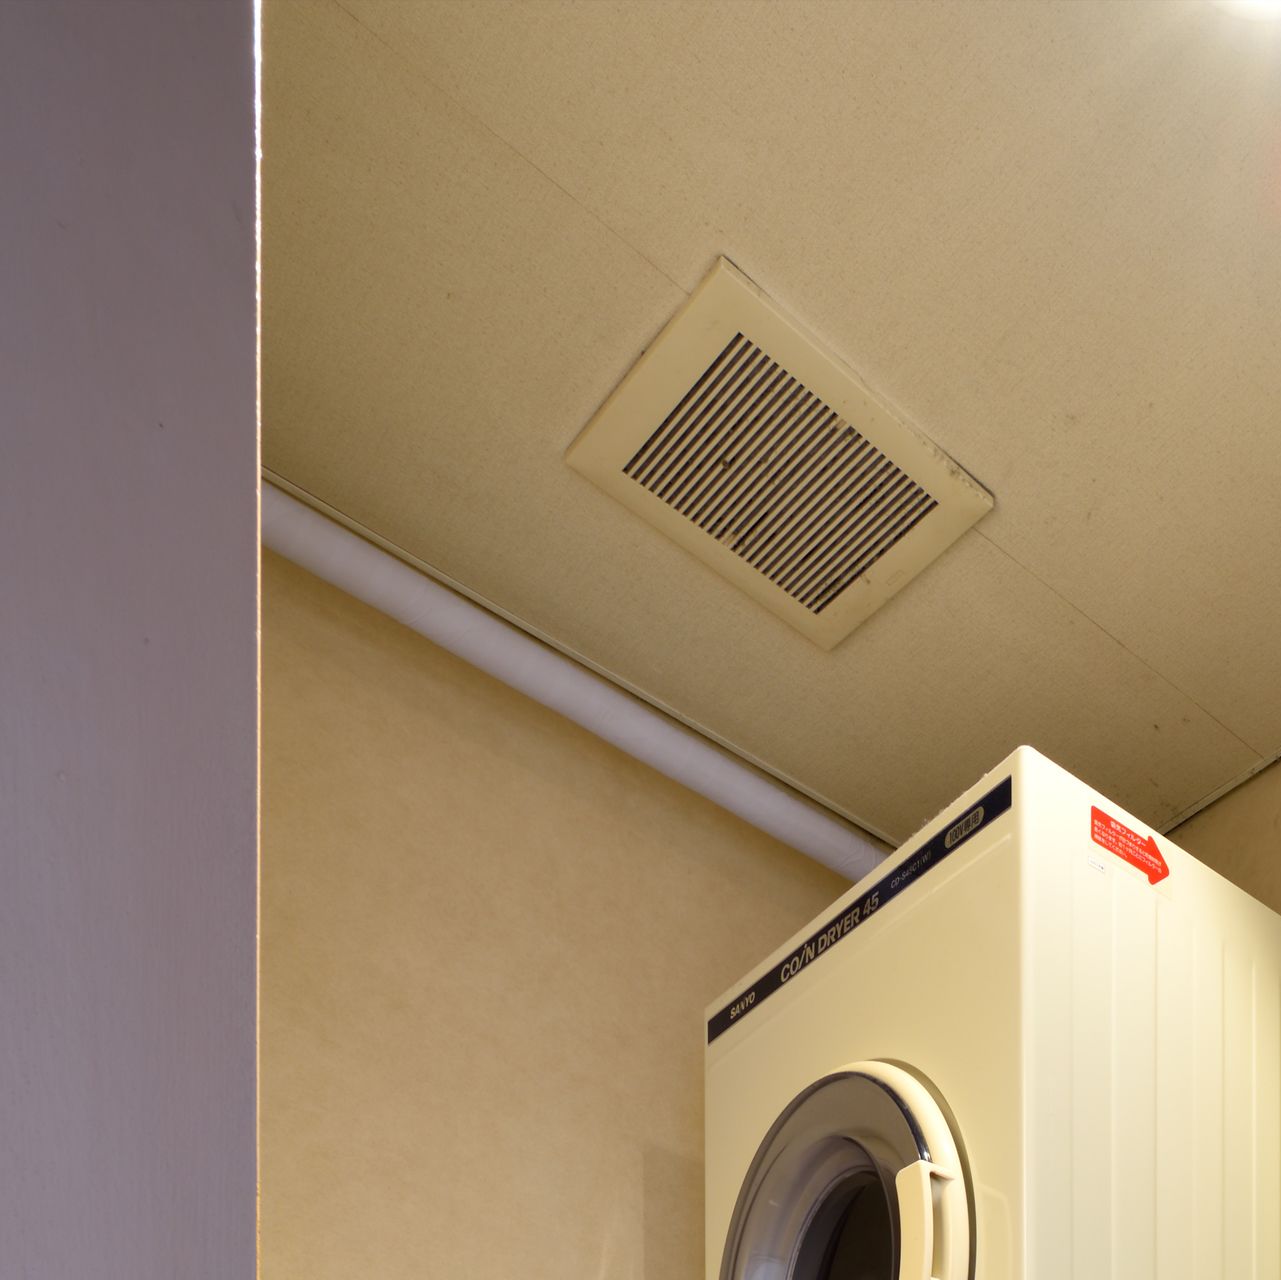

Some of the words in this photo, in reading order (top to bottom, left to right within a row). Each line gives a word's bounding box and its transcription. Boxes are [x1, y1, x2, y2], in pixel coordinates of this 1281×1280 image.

[817, 906, 860, 954] DRYER
[862, 891, 880, 915] 45
[730, 991, 756, 1019] SANYO
